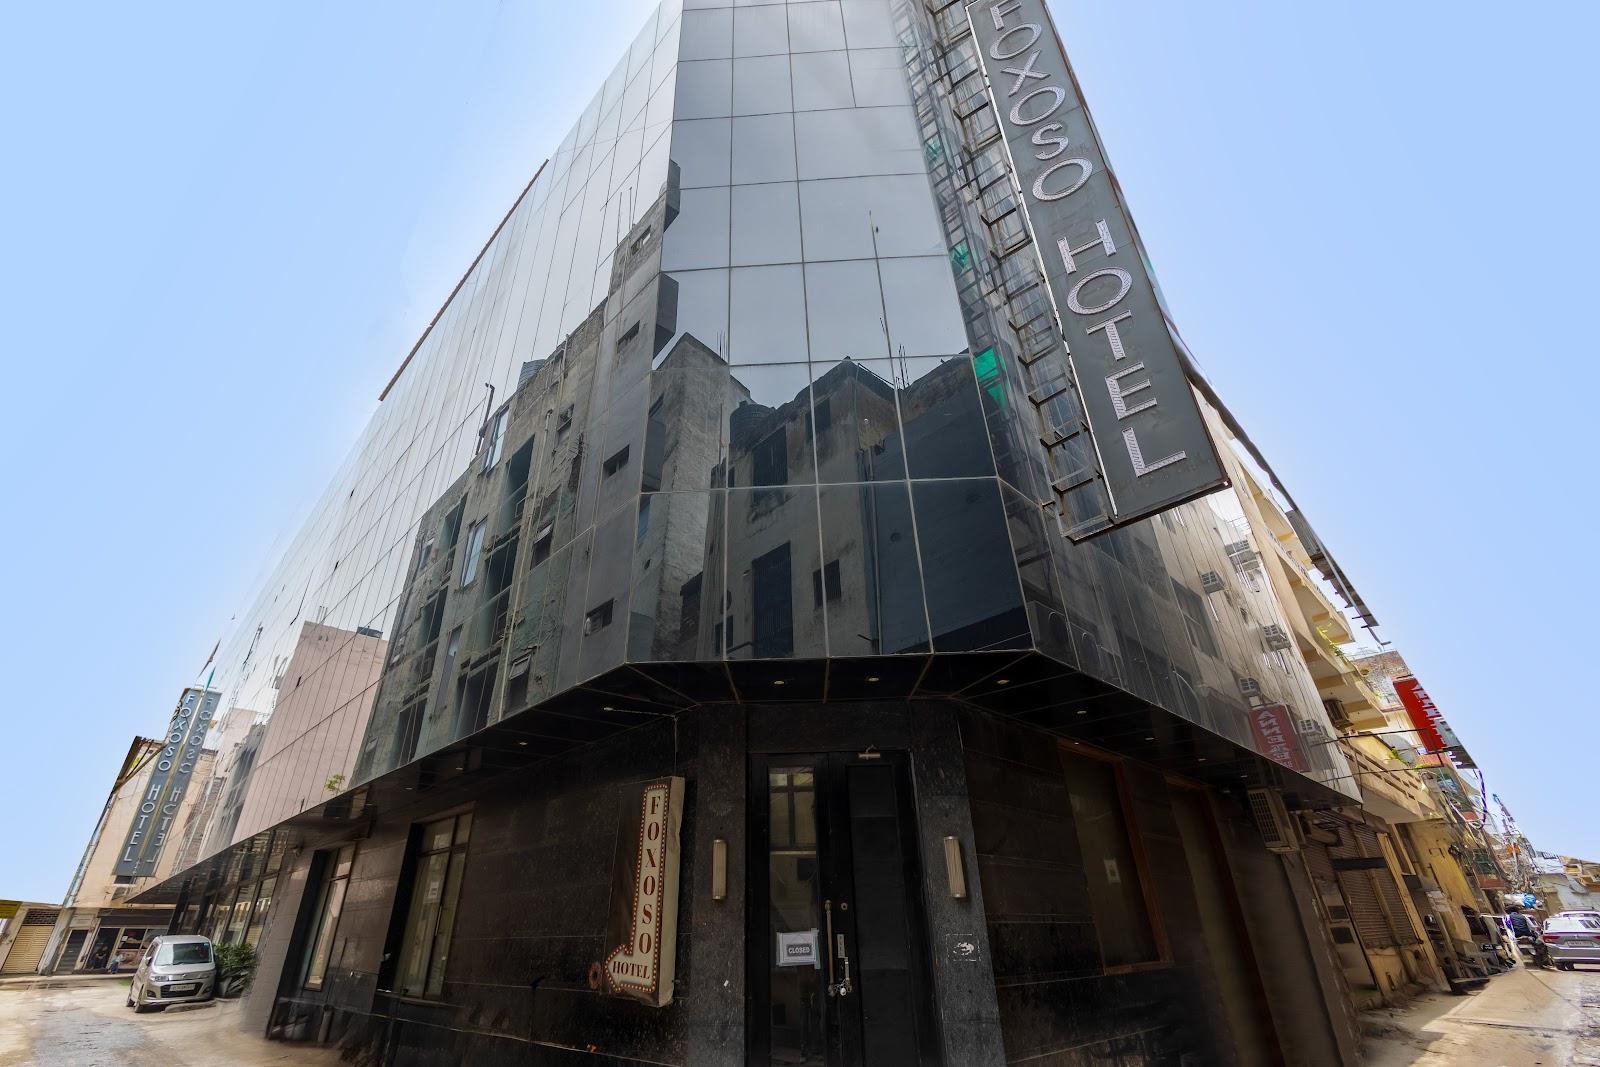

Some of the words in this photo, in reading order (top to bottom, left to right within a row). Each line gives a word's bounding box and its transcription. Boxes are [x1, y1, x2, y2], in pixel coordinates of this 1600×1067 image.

[990, 0, 1093, 201] FOXOSO
[1057, 218, 1187, 478] HOTEL
[158, 694, 196, 771] FOXOSO
[123, 784, 162, 862] HOTEL
[638, 796, 661, 955] FOXOSO
[612, 961, 651, 980] HOTEL
[788, 946, 811, 954] CLOSED
